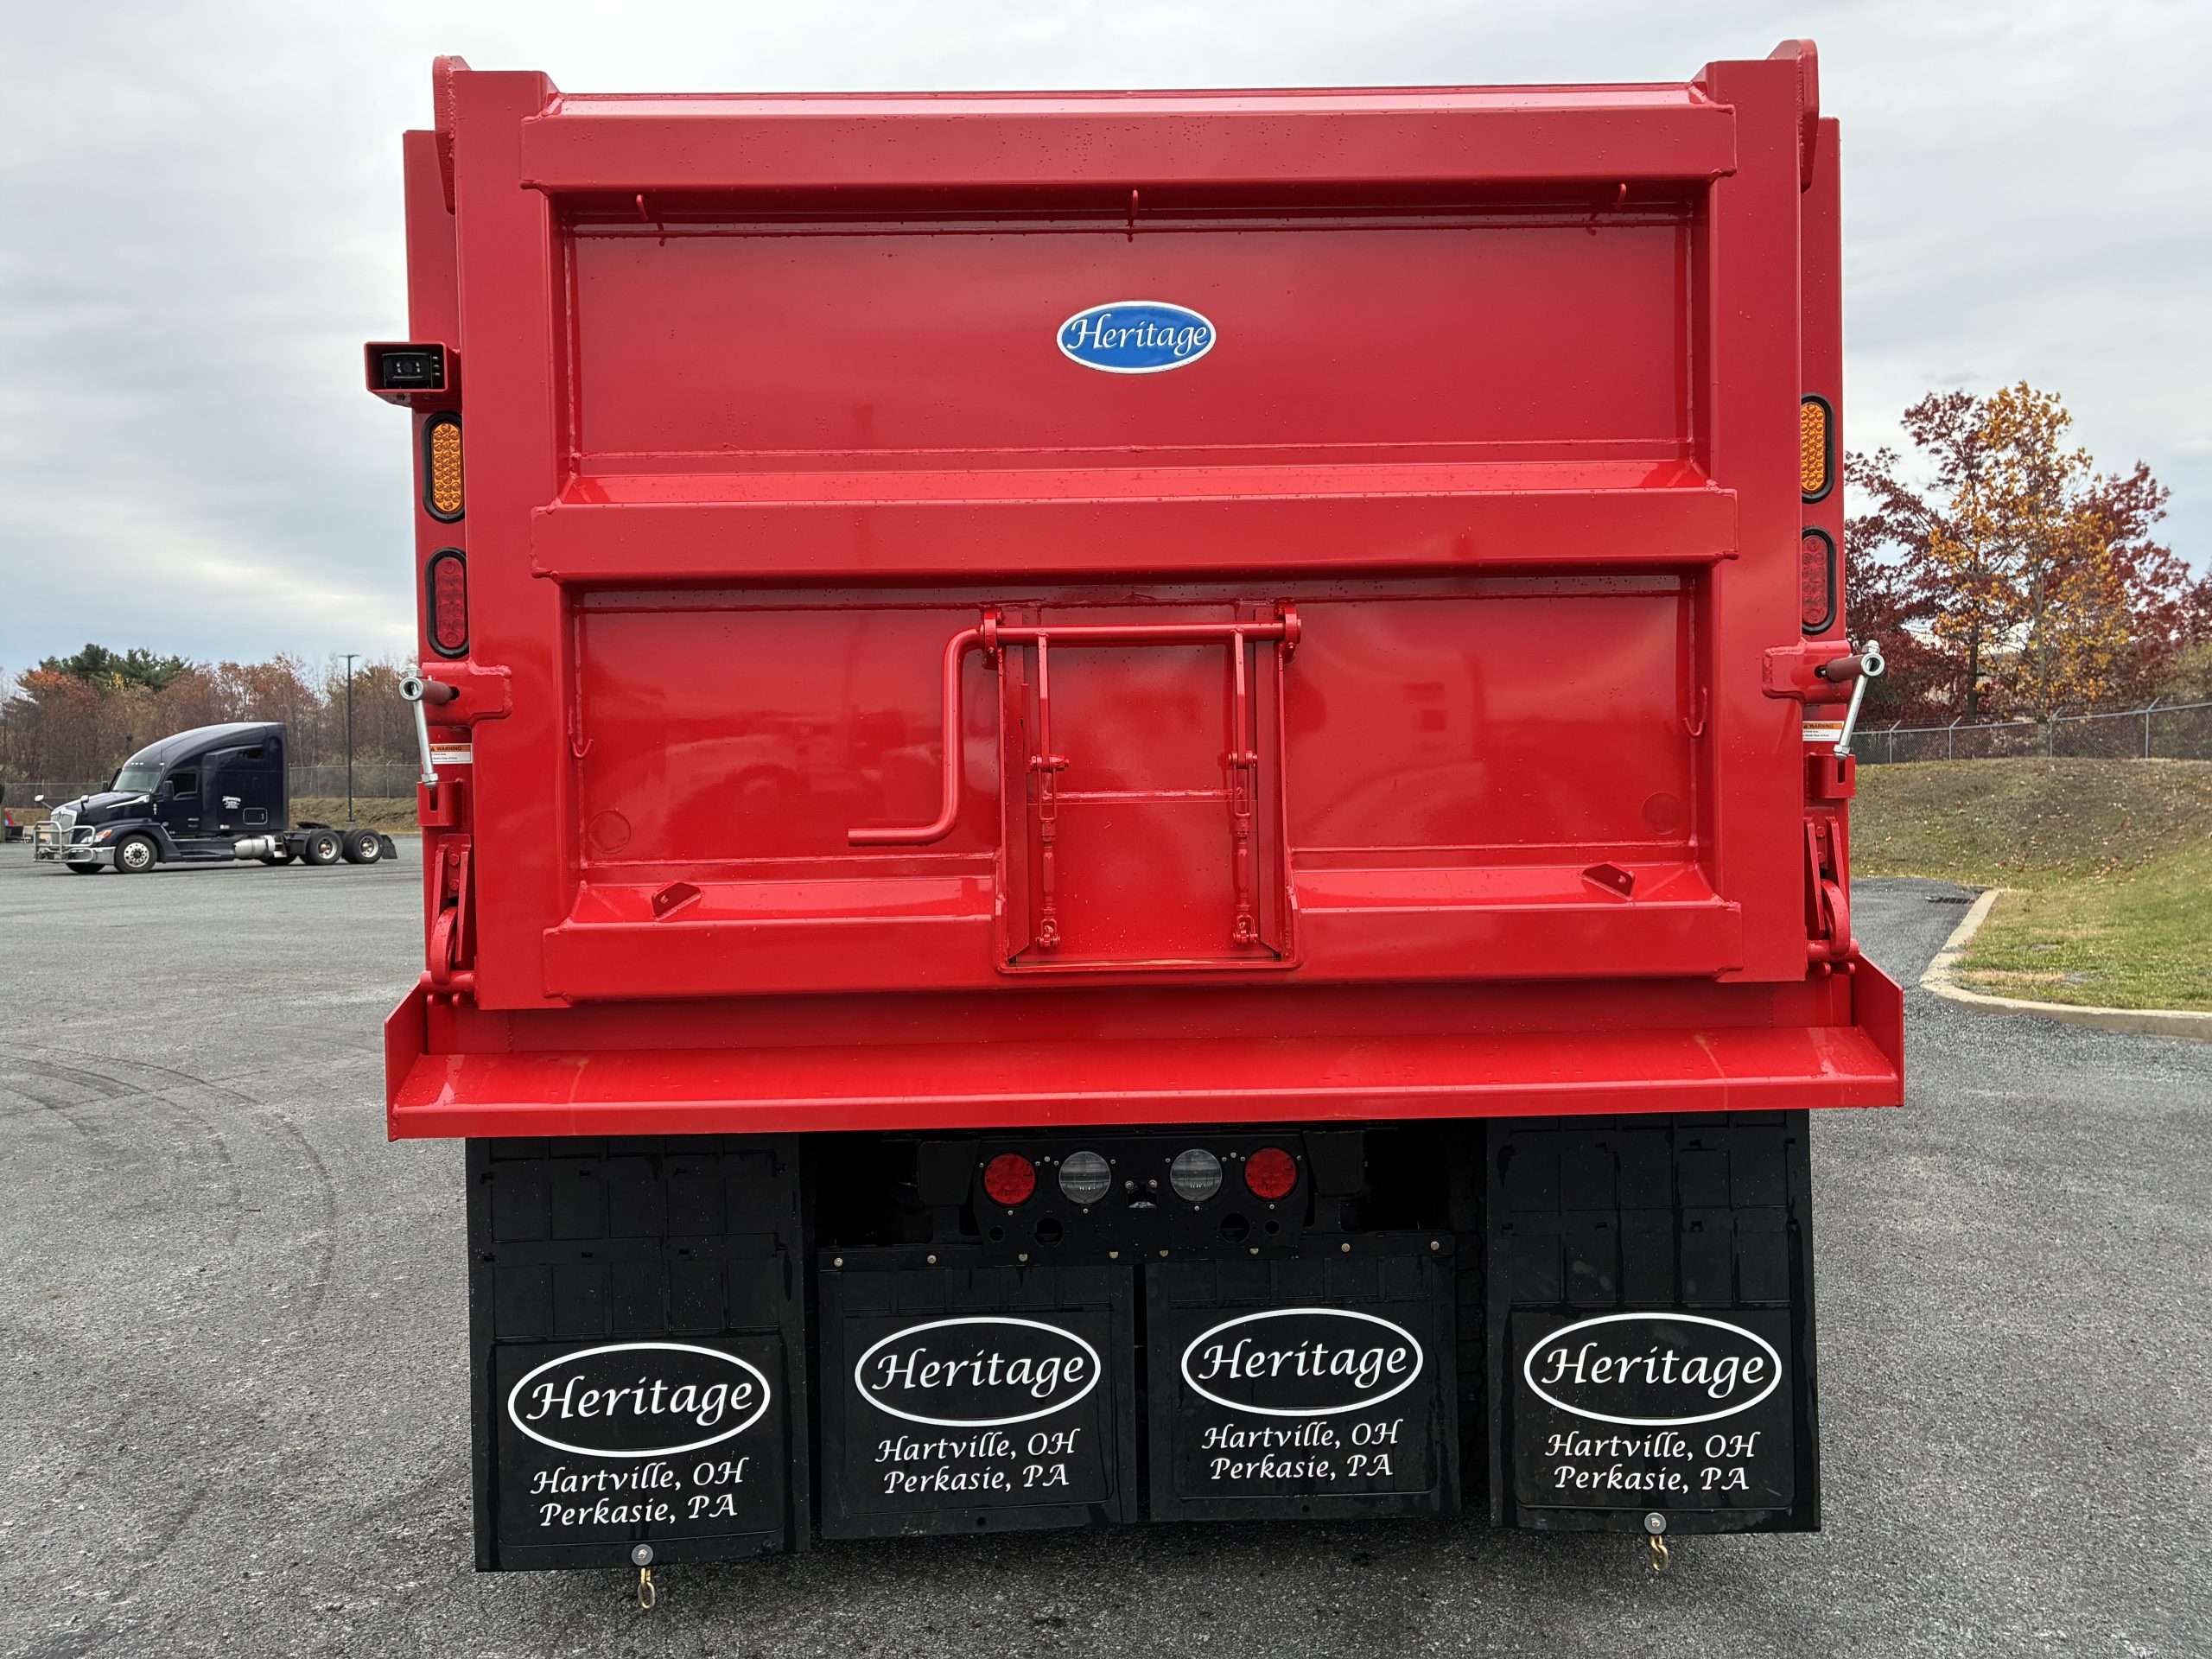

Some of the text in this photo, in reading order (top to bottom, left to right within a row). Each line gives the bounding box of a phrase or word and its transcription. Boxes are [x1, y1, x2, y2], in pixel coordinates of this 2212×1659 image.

[1066, 313, 1208, 357] Heritage
[871, 1348, 1084, 1398] Heritage
[1198, 1338, 1408, 1389] Heritage
[1541, 1343, 1764, 1399] Heritage
[525, 1376, 753, 1427] Heritage
[874, 1428, 1081, 1462] Hartville, OH
[1201, 1419, 1404, 1449] Hartville, OH
[1544, 1431, 1761, 1460] Hartville, OH
[530, 1457, 750, 1495] Hartville, OH
[883, 1464, 1070, 1494] Perkasie, PA
[1210, 1454, 1394, 1481] Perkasie, PA
[1554, 1463, 1750, 1494] Perkasie, PA
[539, 1493, 738, 1527] Perkasie, PA
